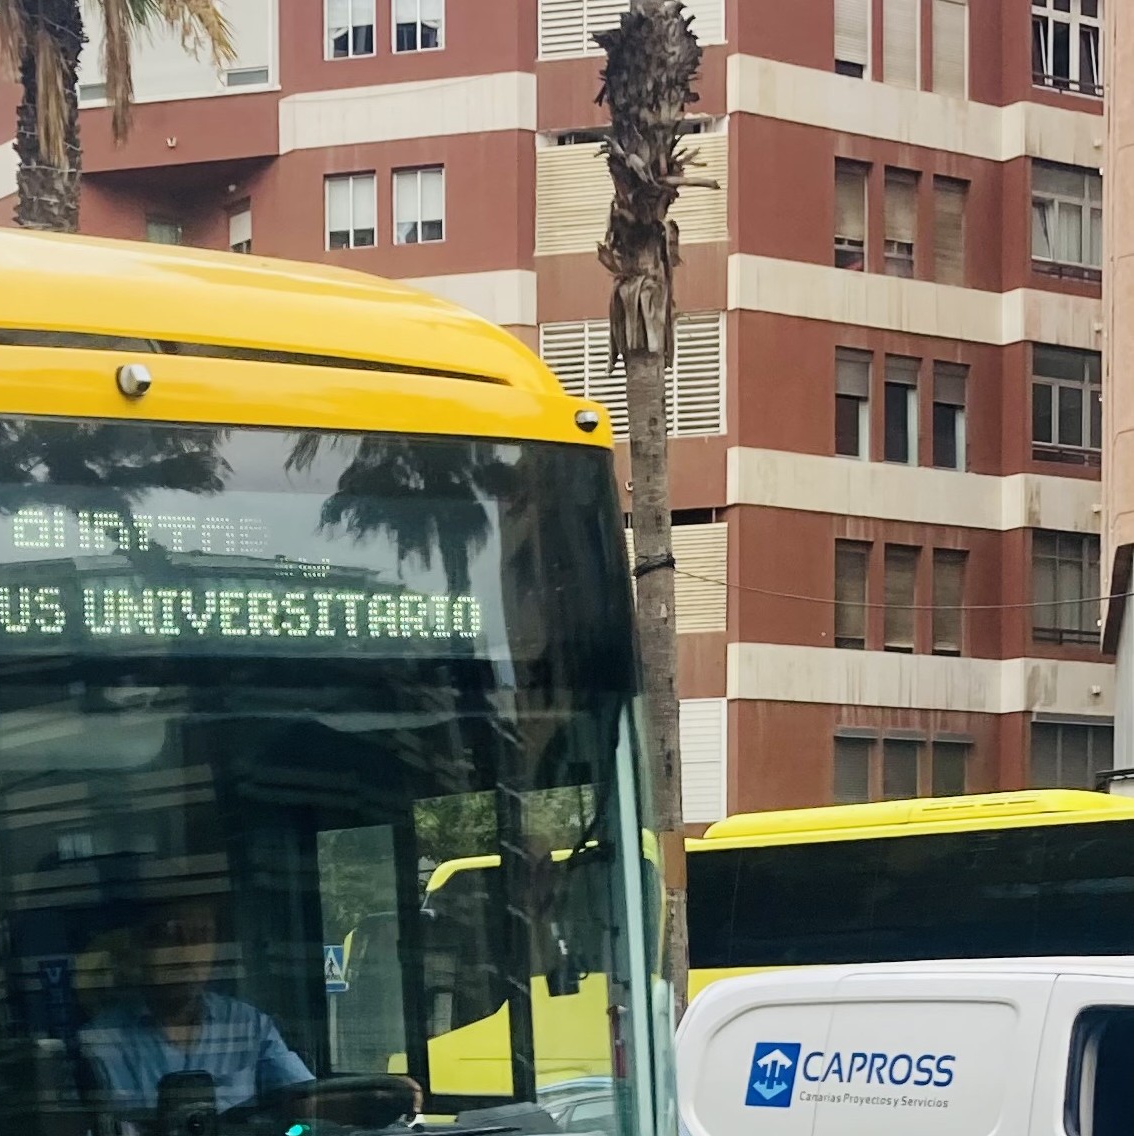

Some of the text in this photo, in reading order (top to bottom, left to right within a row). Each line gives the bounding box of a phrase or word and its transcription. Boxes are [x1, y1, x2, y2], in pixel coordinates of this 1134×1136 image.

[84, 587, 481, 638] UNIVERSITARIO
[802, 1051, 956, 1087] CAPROSS
[799, 1090, 841, 1103] Canarias
[843, 1093, 892, 1106] Proyectos
[901, 1095, 949, 1108] Servicios
